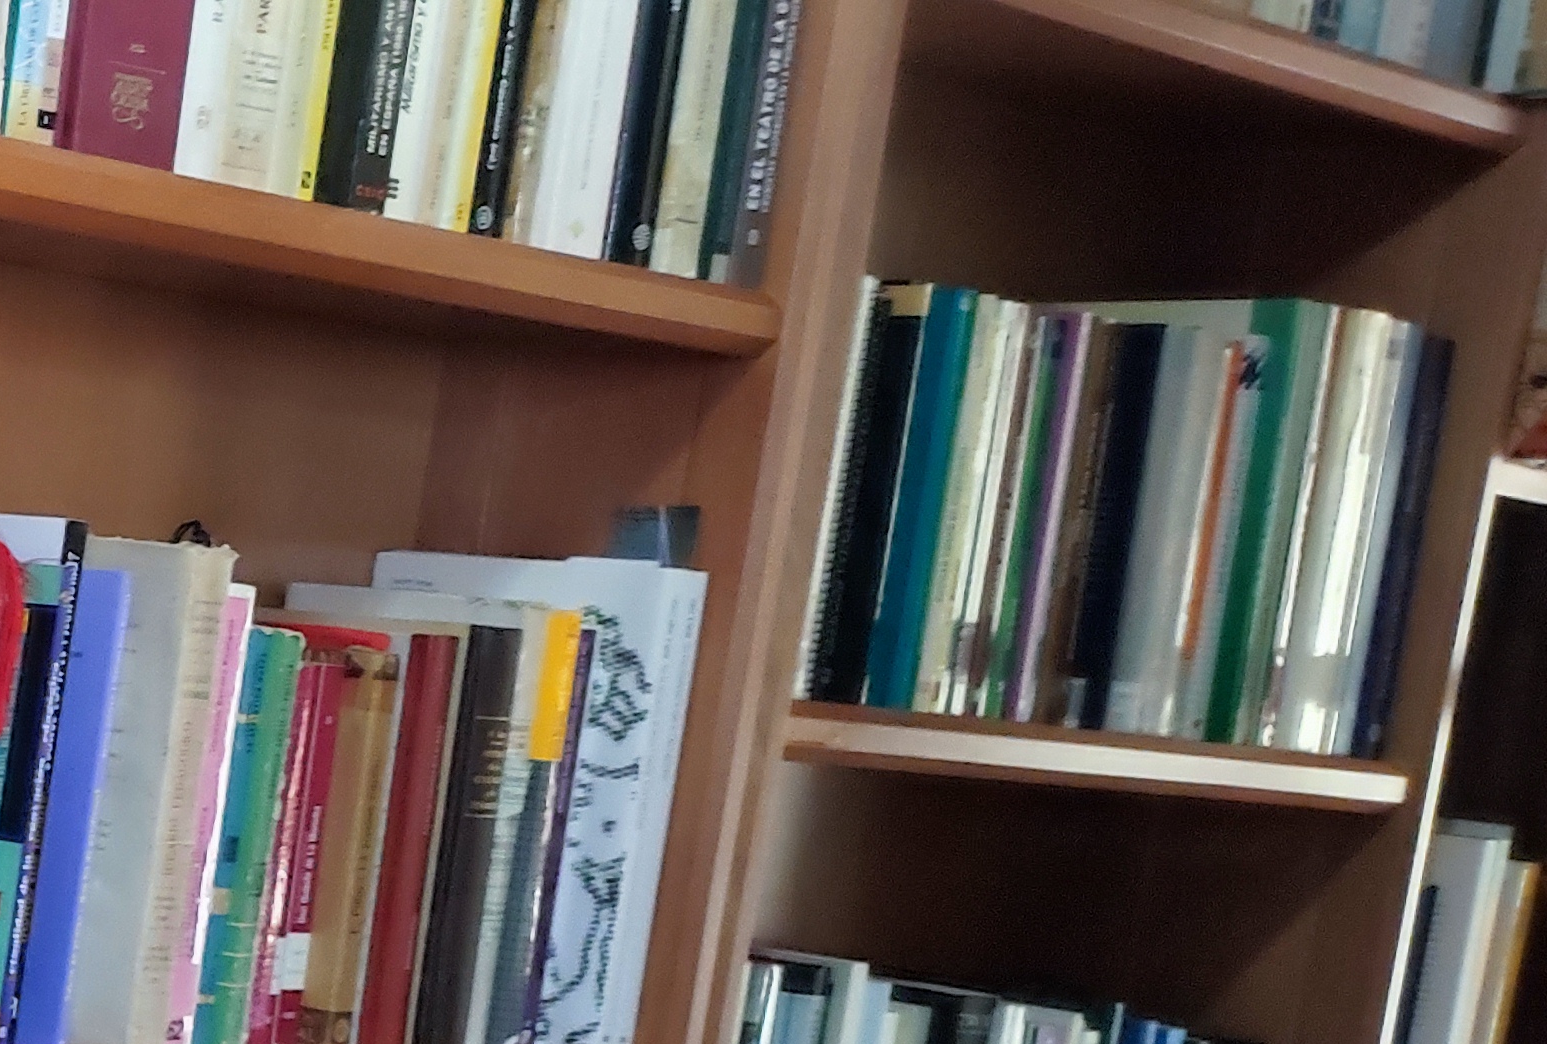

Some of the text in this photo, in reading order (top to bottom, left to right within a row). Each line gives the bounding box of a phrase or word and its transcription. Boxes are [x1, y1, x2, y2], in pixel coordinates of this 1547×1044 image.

[744, 17, 786, 211] EN EL TEATRO DE LA
